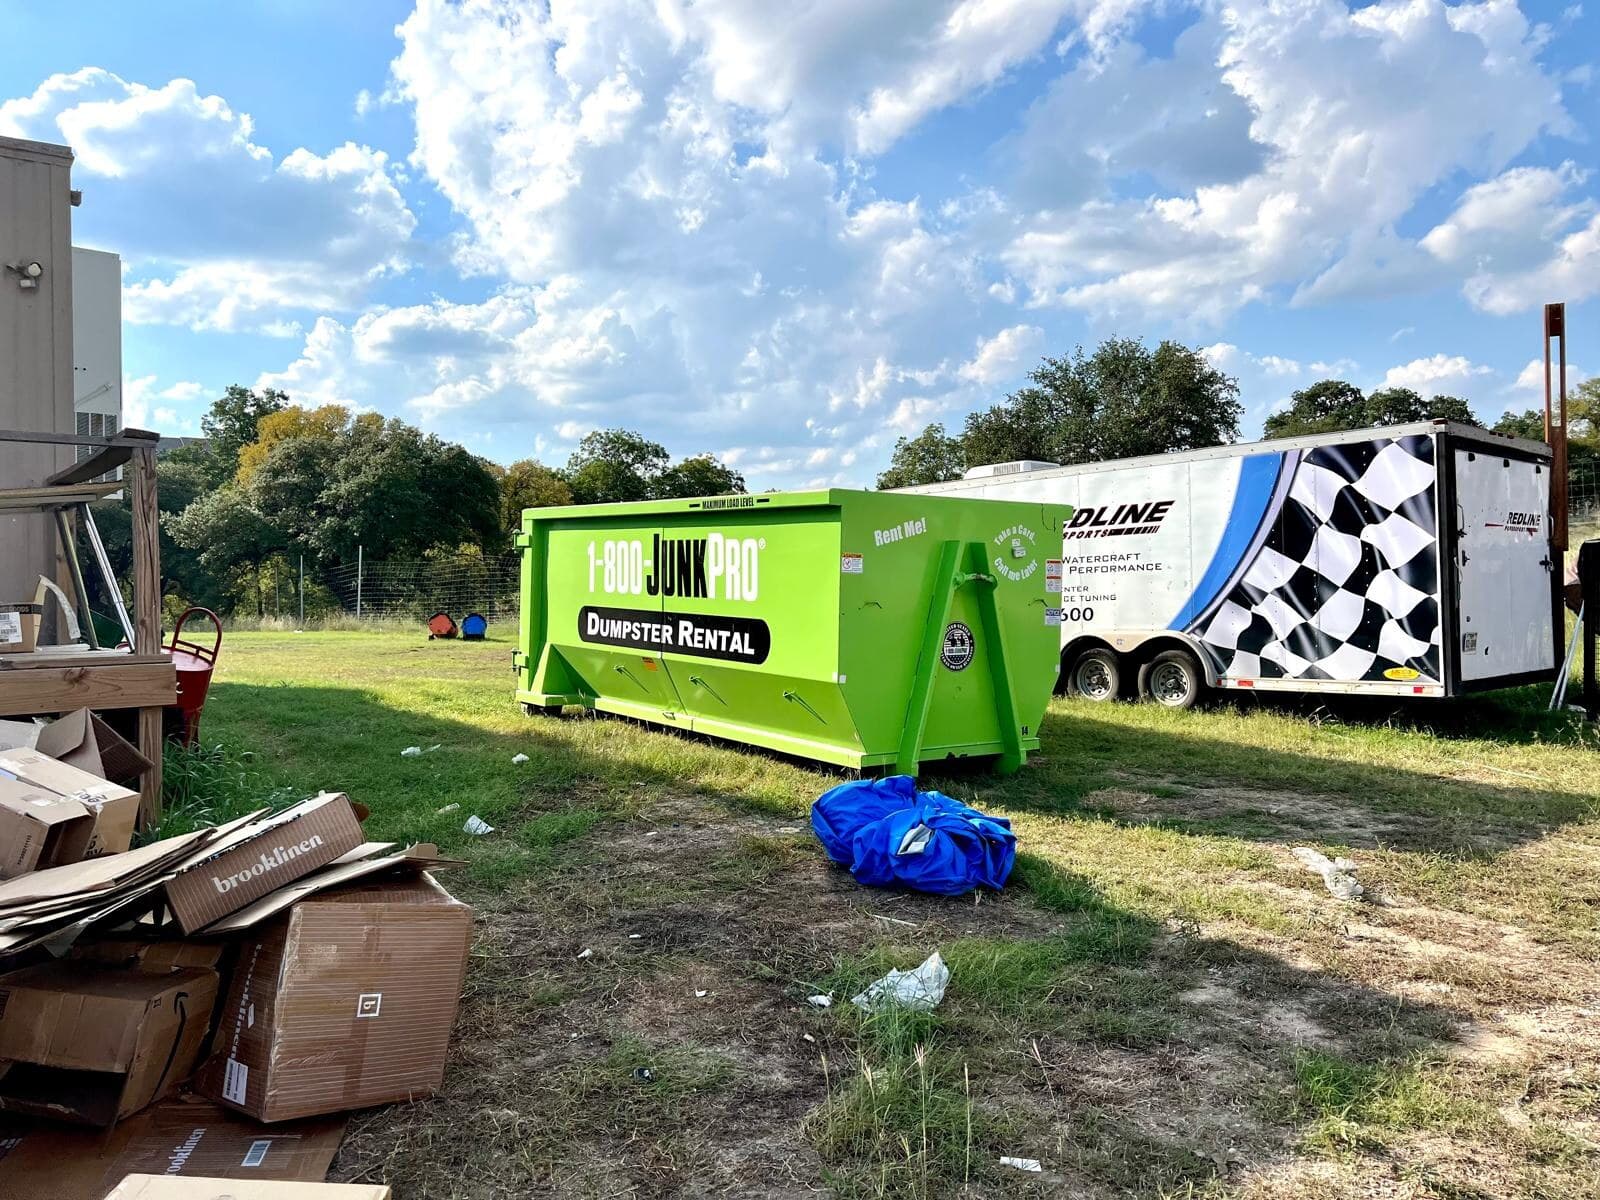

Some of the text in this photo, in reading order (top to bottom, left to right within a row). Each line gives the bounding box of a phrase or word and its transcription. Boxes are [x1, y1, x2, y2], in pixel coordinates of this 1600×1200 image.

[1064, 500, 1176, 528] DLINE
[1507, 511, 1541, 526] REDLINE
[874, 517, 927, 547] Rent Me!
[1062, 553, 1141, 565] WATERCRAFT
[1069, 562, 1163, 575] PERFORMANCE
[1080, 594, 1117, 602] TUNING
[211, 834, 324, 893] brooklinen
[164, 1128, 207, 1176] ooklinen
